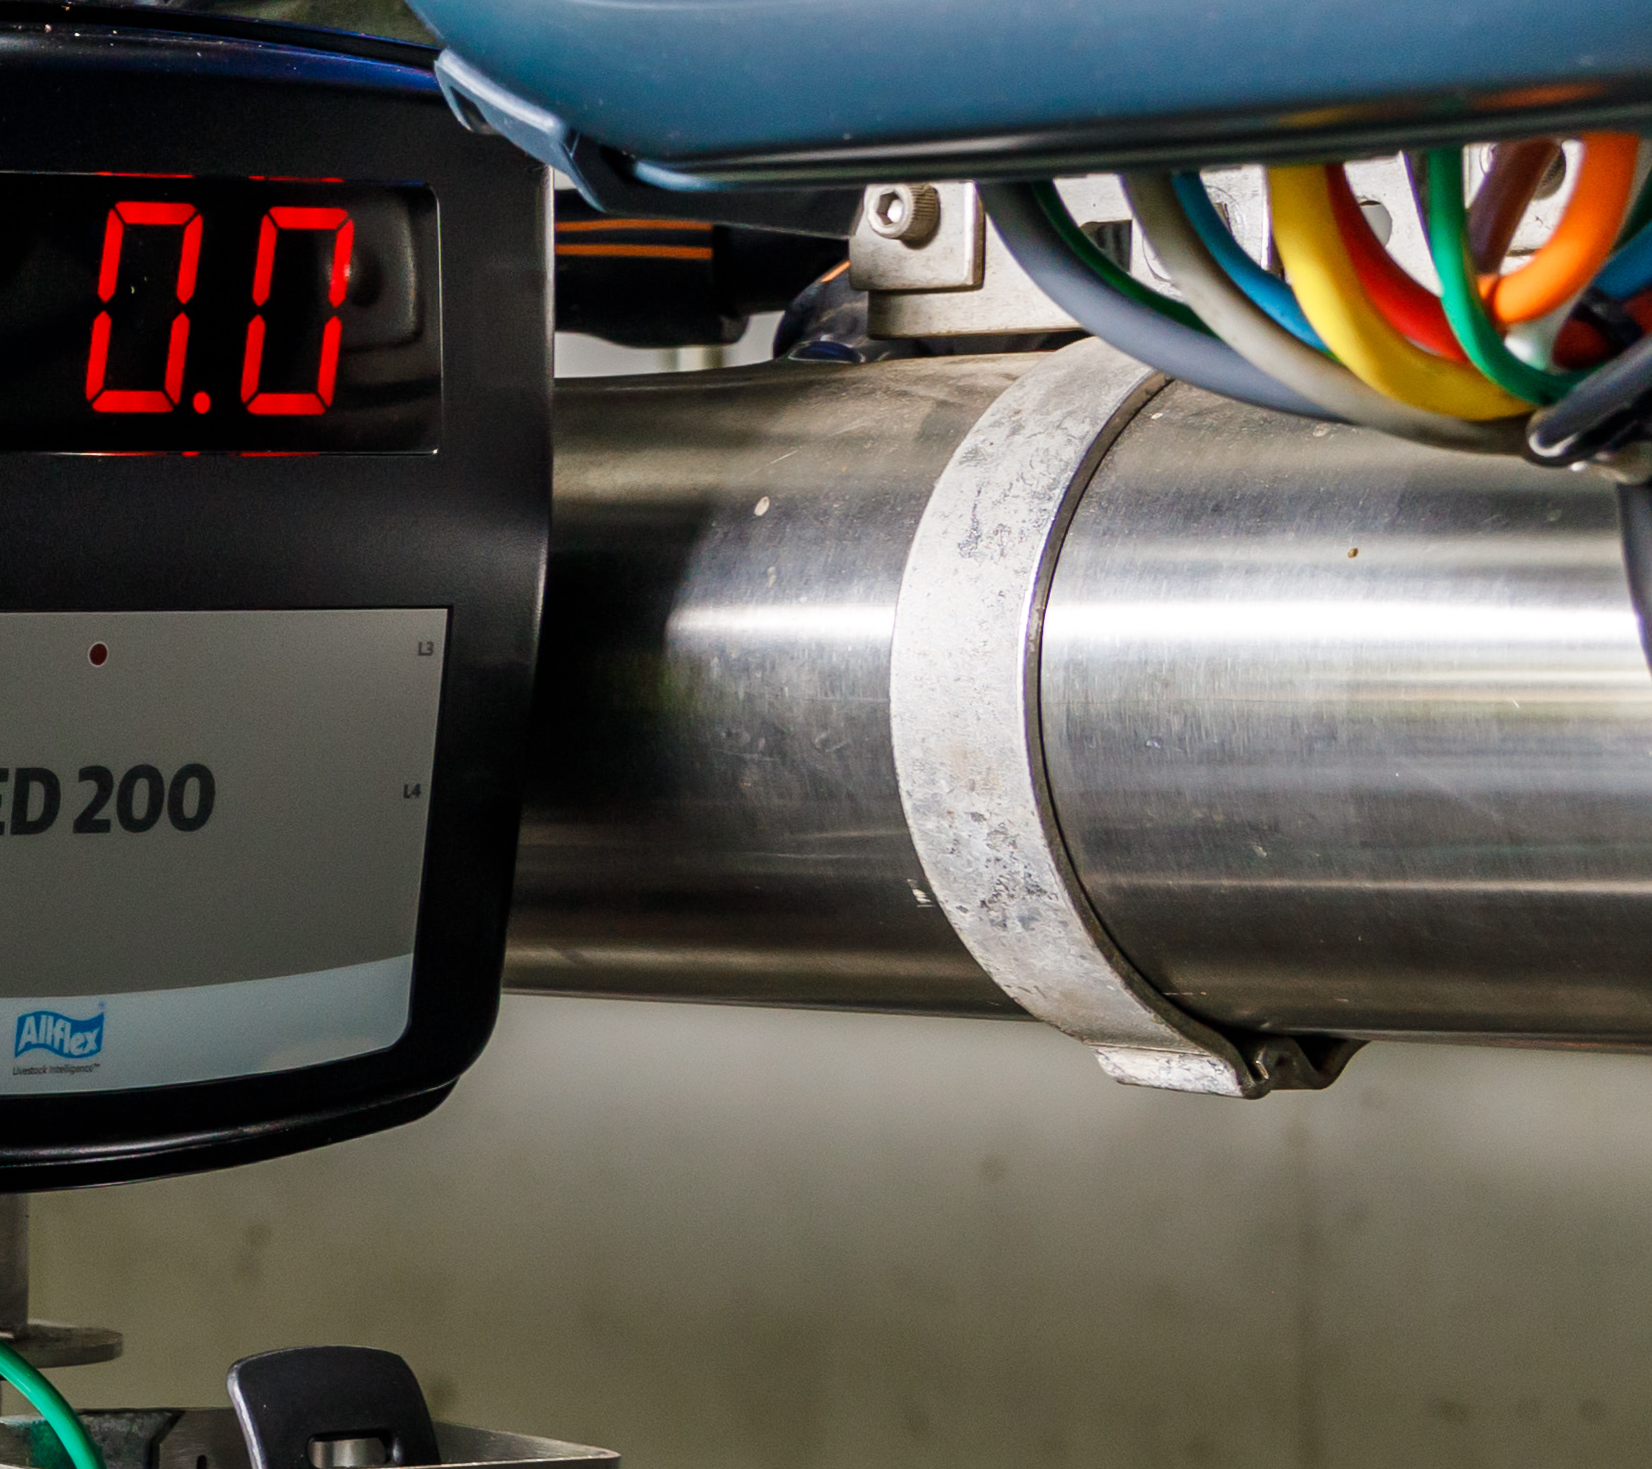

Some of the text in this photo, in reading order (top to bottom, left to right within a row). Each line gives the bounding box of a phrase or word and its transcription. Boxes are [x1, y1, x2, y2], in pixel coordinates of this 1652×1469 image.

[85, 200, 354, 416] 0.0
[418, 641, 434, 656] L3
[73, 763, 216, 833] 200
[403, 783, 422, 799] L4
[16, 1014, 102, 1057] Allflex
